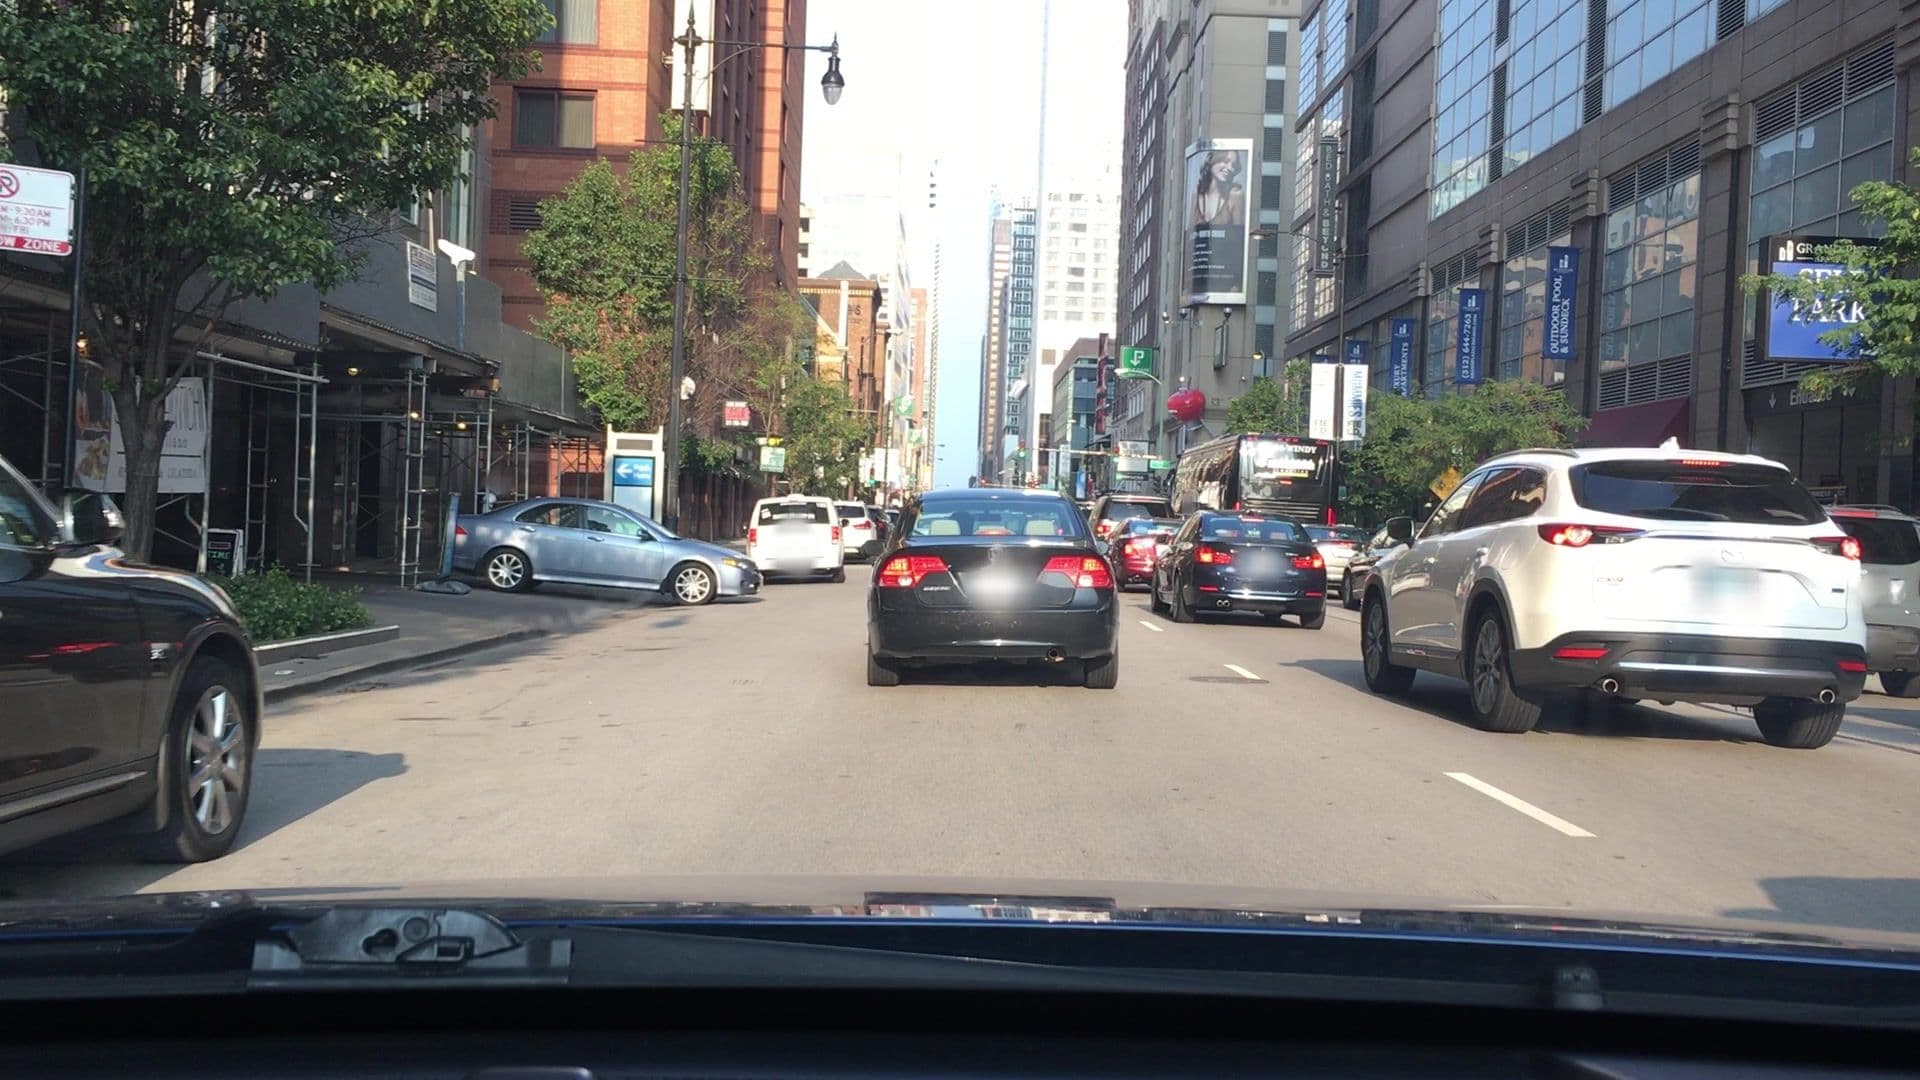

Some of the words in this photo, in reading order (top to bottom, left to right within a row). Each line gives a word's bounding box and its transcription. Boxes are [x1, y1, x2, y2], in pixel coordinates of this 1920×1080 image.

[1325, 145, 1333, 170] BED
[1323, 173, 1332, 206] BATH
[23, 239, 61, 251] ZONE
[1321, 219, 1330, 269] BEYOND
[1552, 275, 1563, 302] POOL
[1550, 304, 1561, 354] OUTDOOR
[1560, 298, 1570, 344] SUNDECK
[1560, 346, 1569, 354] &
[1393, 364, 1401, 390] XURY
[1461, 355, 1470, 379] (312)
